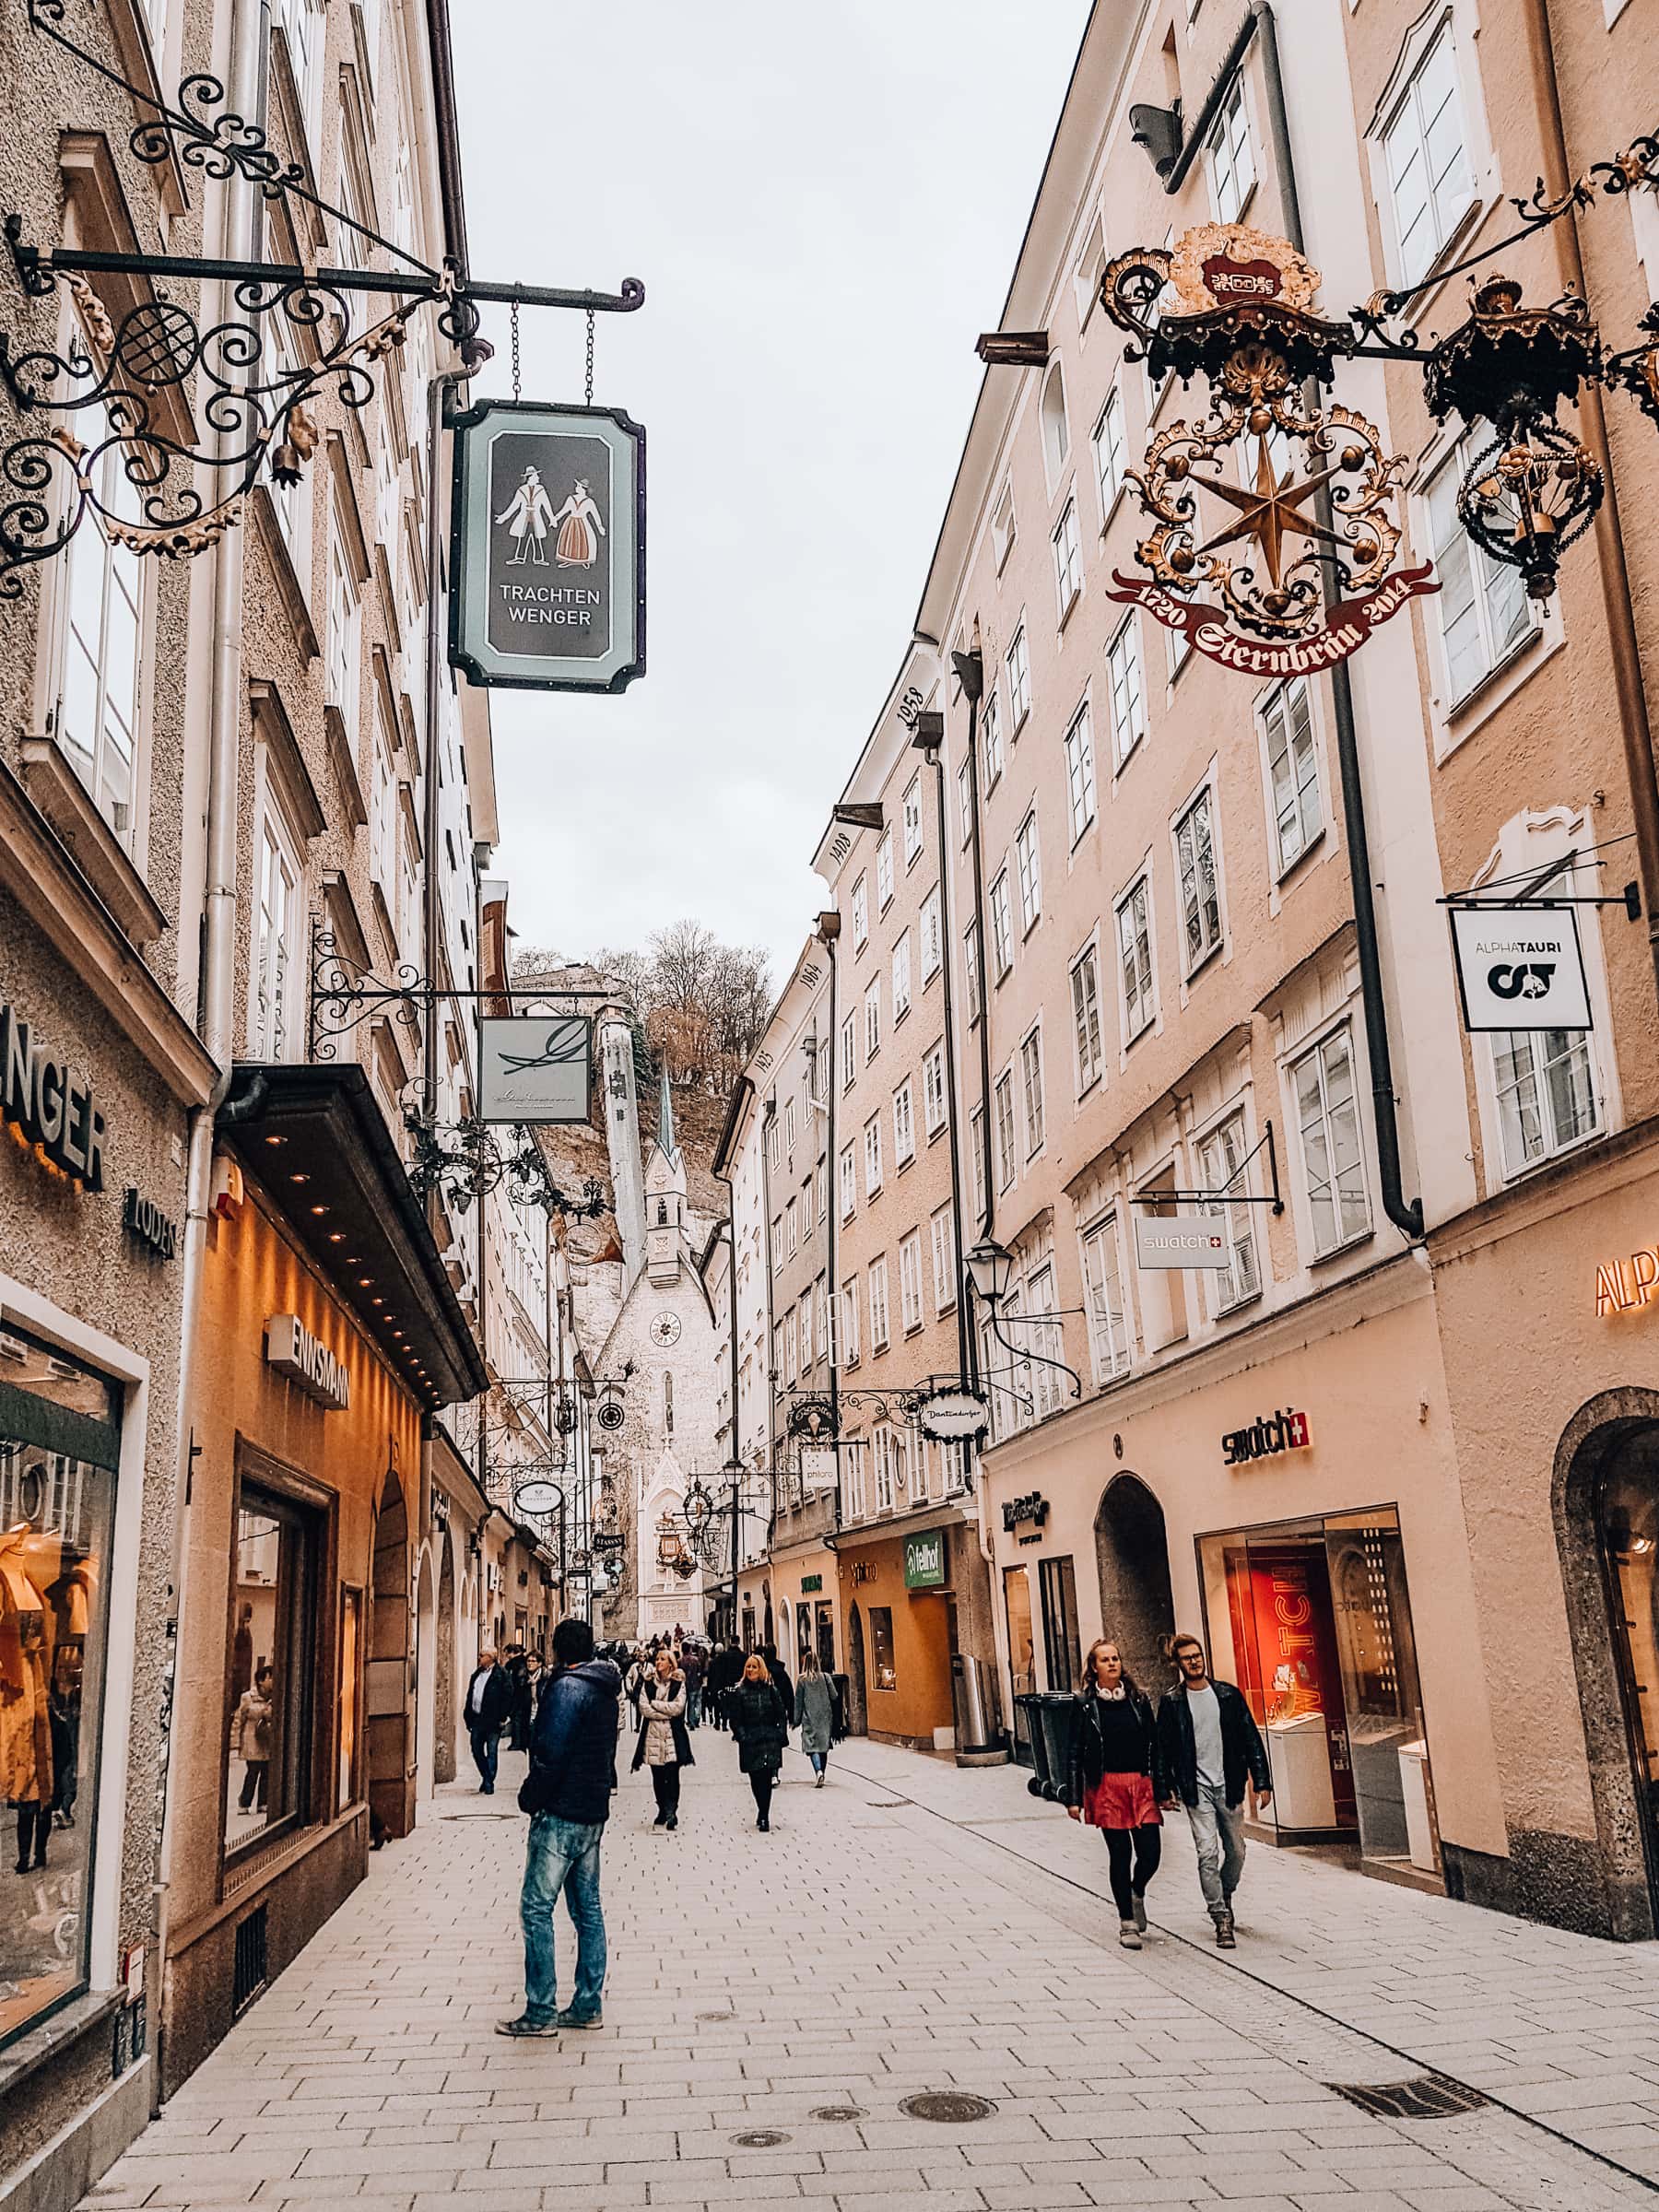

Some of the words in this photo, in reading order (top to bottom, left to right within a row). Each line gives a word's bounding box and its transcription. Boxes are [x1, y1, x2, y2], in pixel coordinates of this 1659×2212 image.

[500, 584, 600, 605] TRACHTEN
[509, 606, 591, 625] WENGER
[1135, 585, 1187, 626] 1720
[1361, 577, 1415, 624] 2014
[1195, 621, 1365, 673] Sternbräu
[830, 832, 850, 866] 1408
[1476, 941, 1562, 954] ALPHATAURI
[0, 1003, 108, 1191] NGER
[1143, 1234, 1209, 1249] swatch
[1595, 1246, 1659, 1318] ALP
[292, 1314, 351, 1410] ENNSMANN
[1222, 1409, 1293, 1465] swatch
